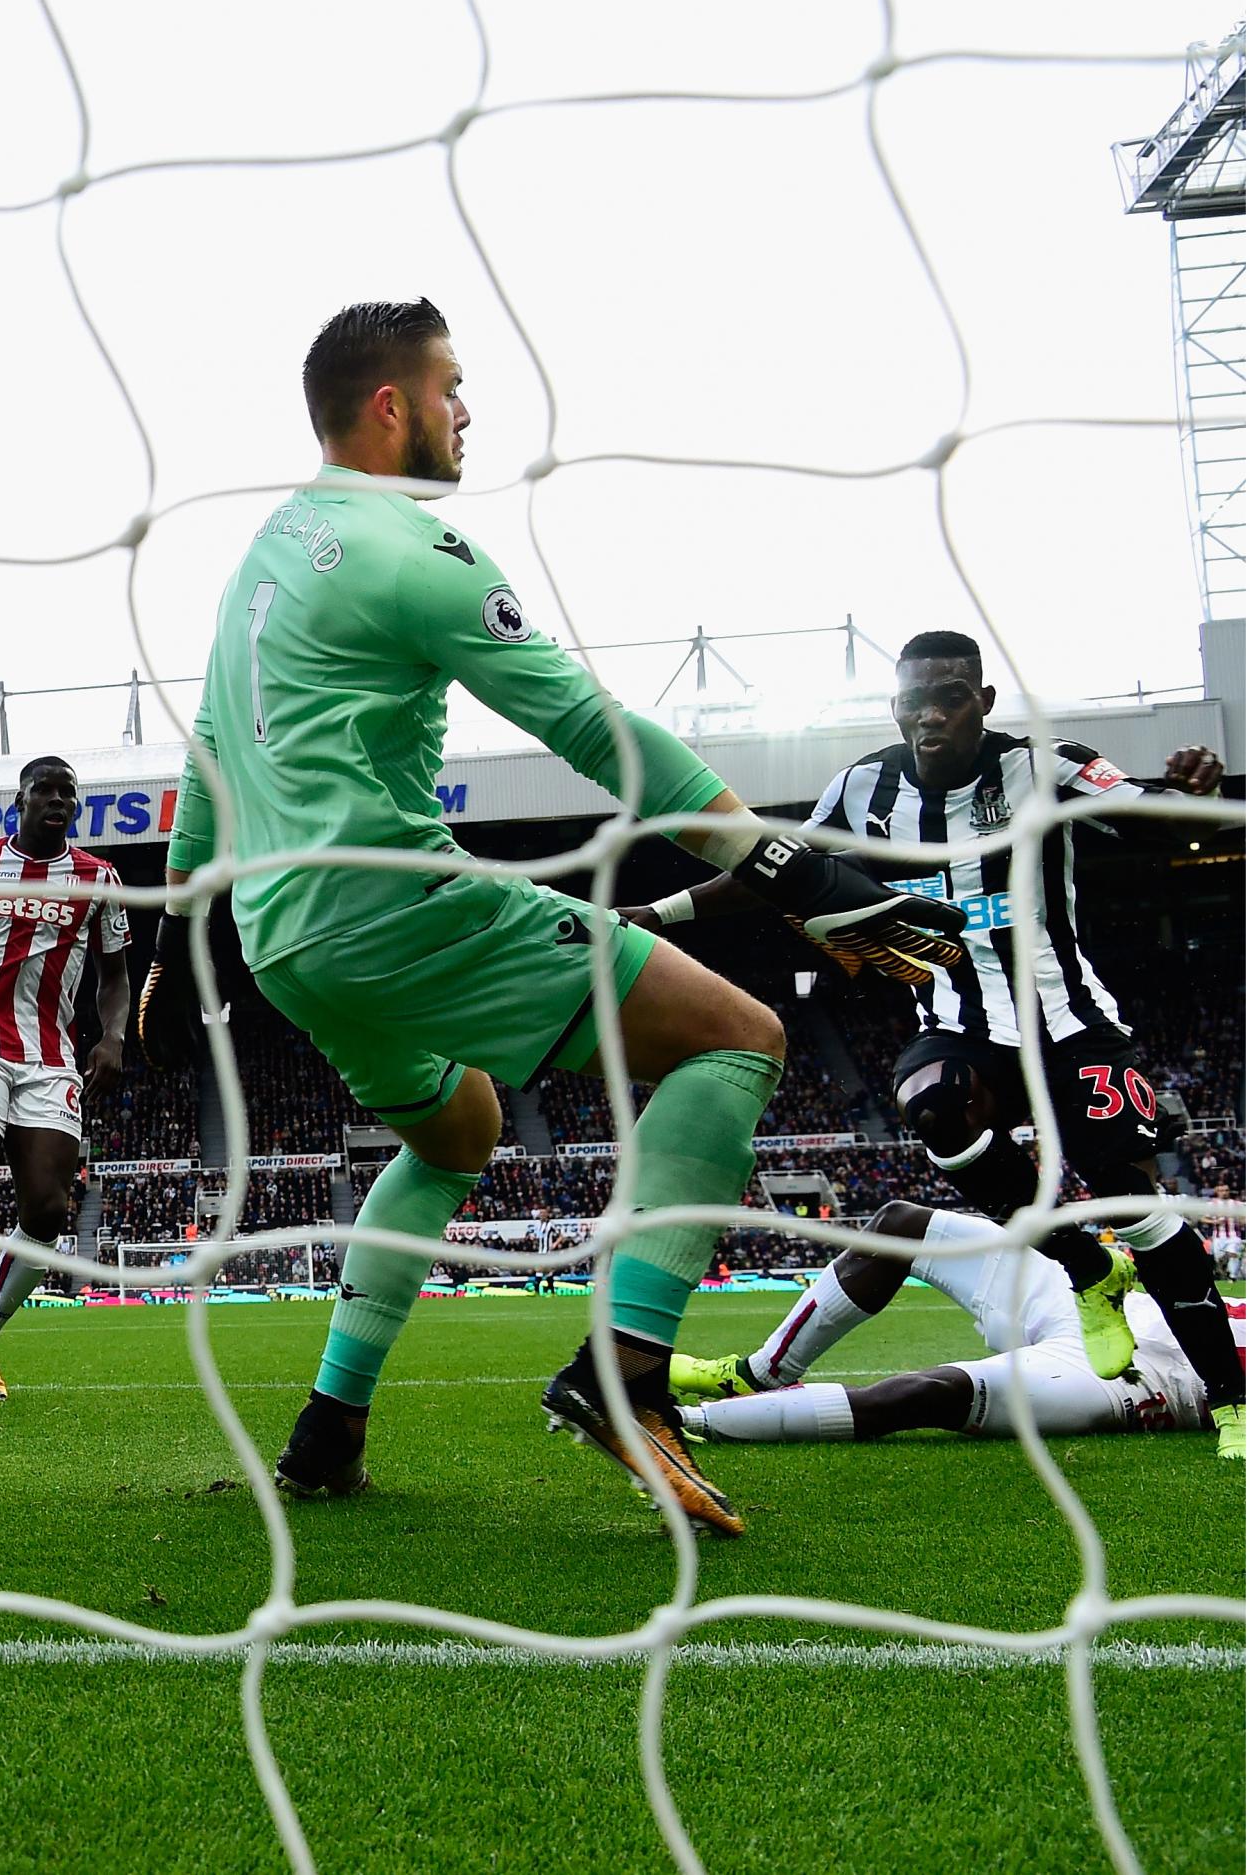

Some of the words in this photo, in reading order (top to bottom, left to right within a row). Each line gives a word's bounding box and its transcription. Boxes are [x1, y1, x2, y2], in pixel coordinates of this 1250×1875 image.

[248, 580, 278, 743] 1
[65, 1082, 80, 1114] 6
[1079, 1064, 1157, 1121] 30
